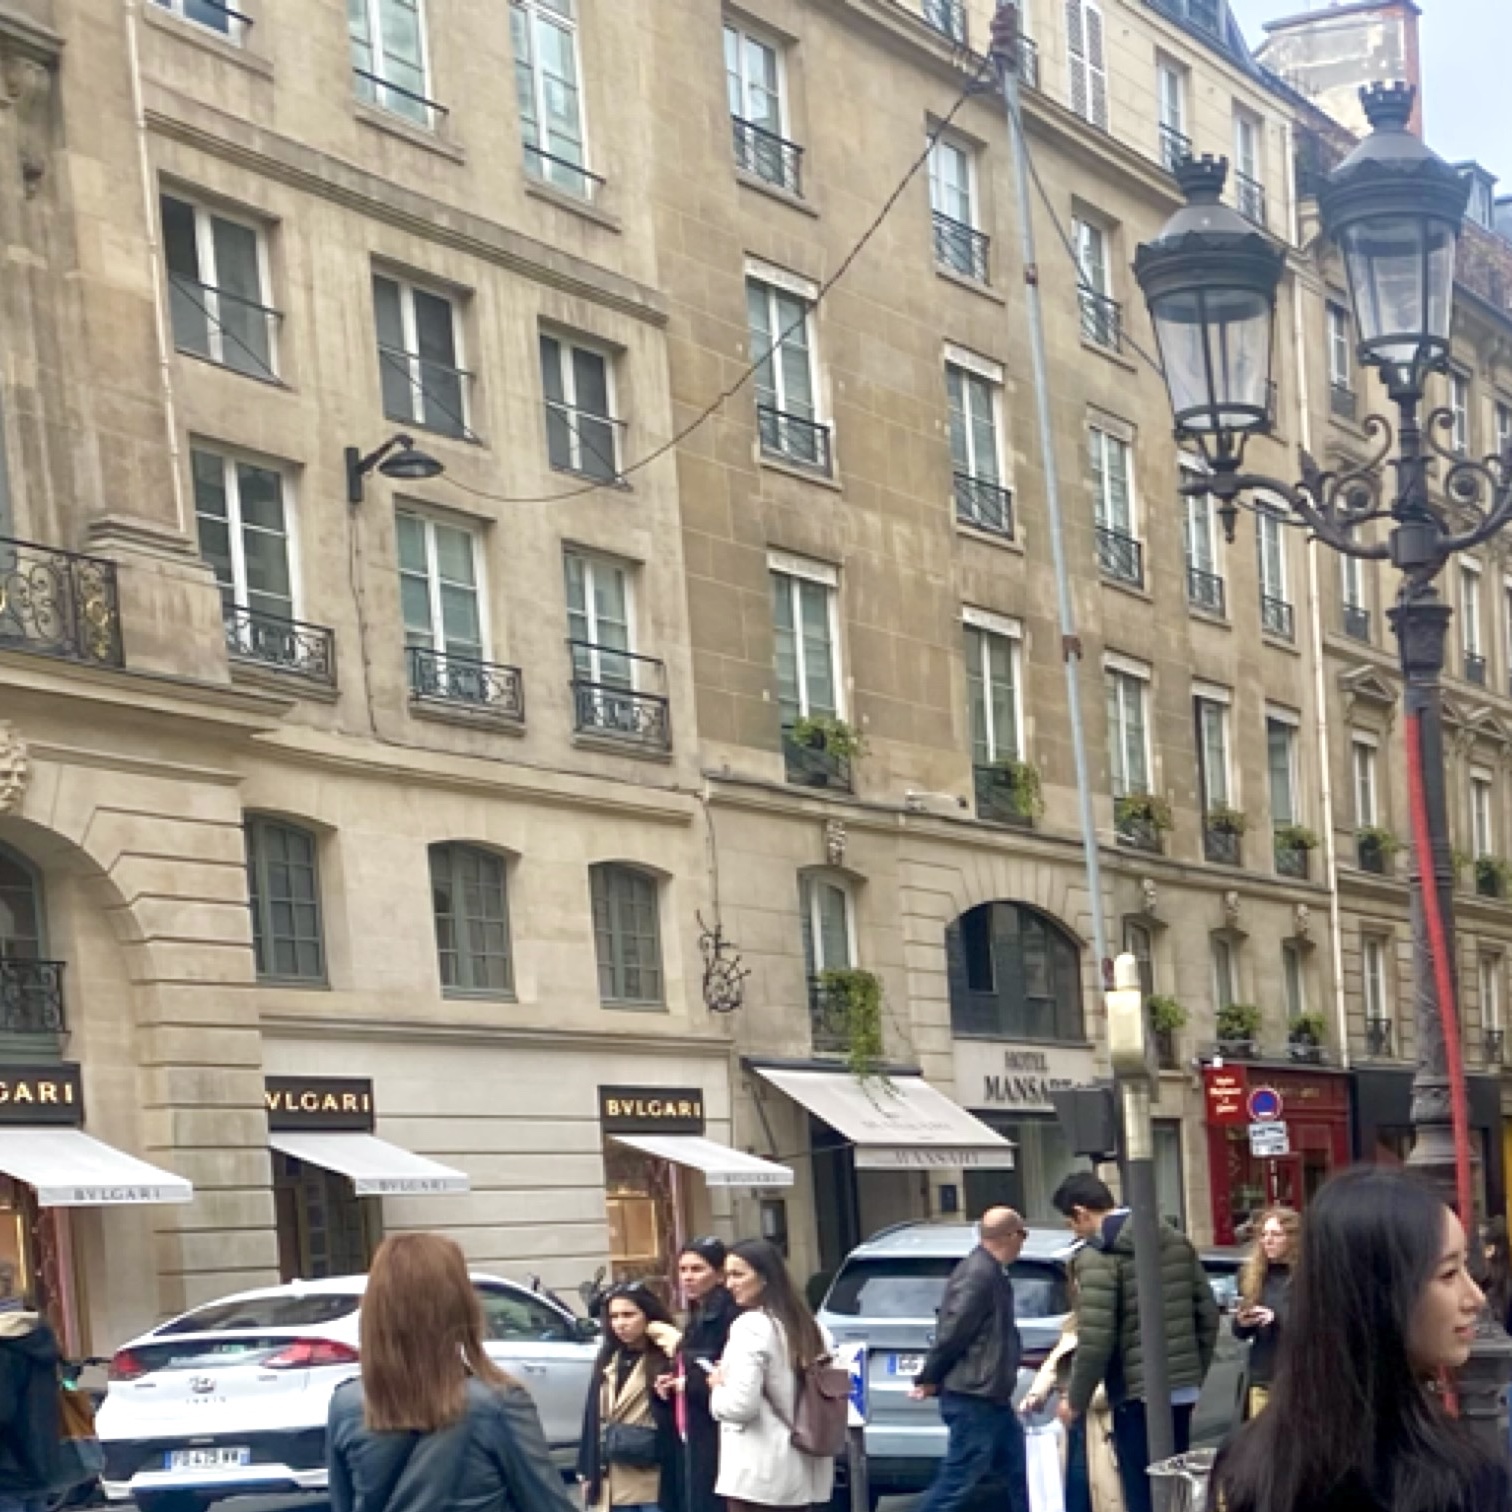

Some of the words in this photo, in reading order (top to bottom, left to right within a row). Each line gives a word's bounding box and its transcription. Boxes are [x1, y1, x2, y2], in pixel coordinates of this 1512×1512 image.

[264, 1091, 370, 1113] VLGARI
[605, 1099, 701, 1119] BVLGARI
[73, 1187, 161, 1201] BVLGARI
